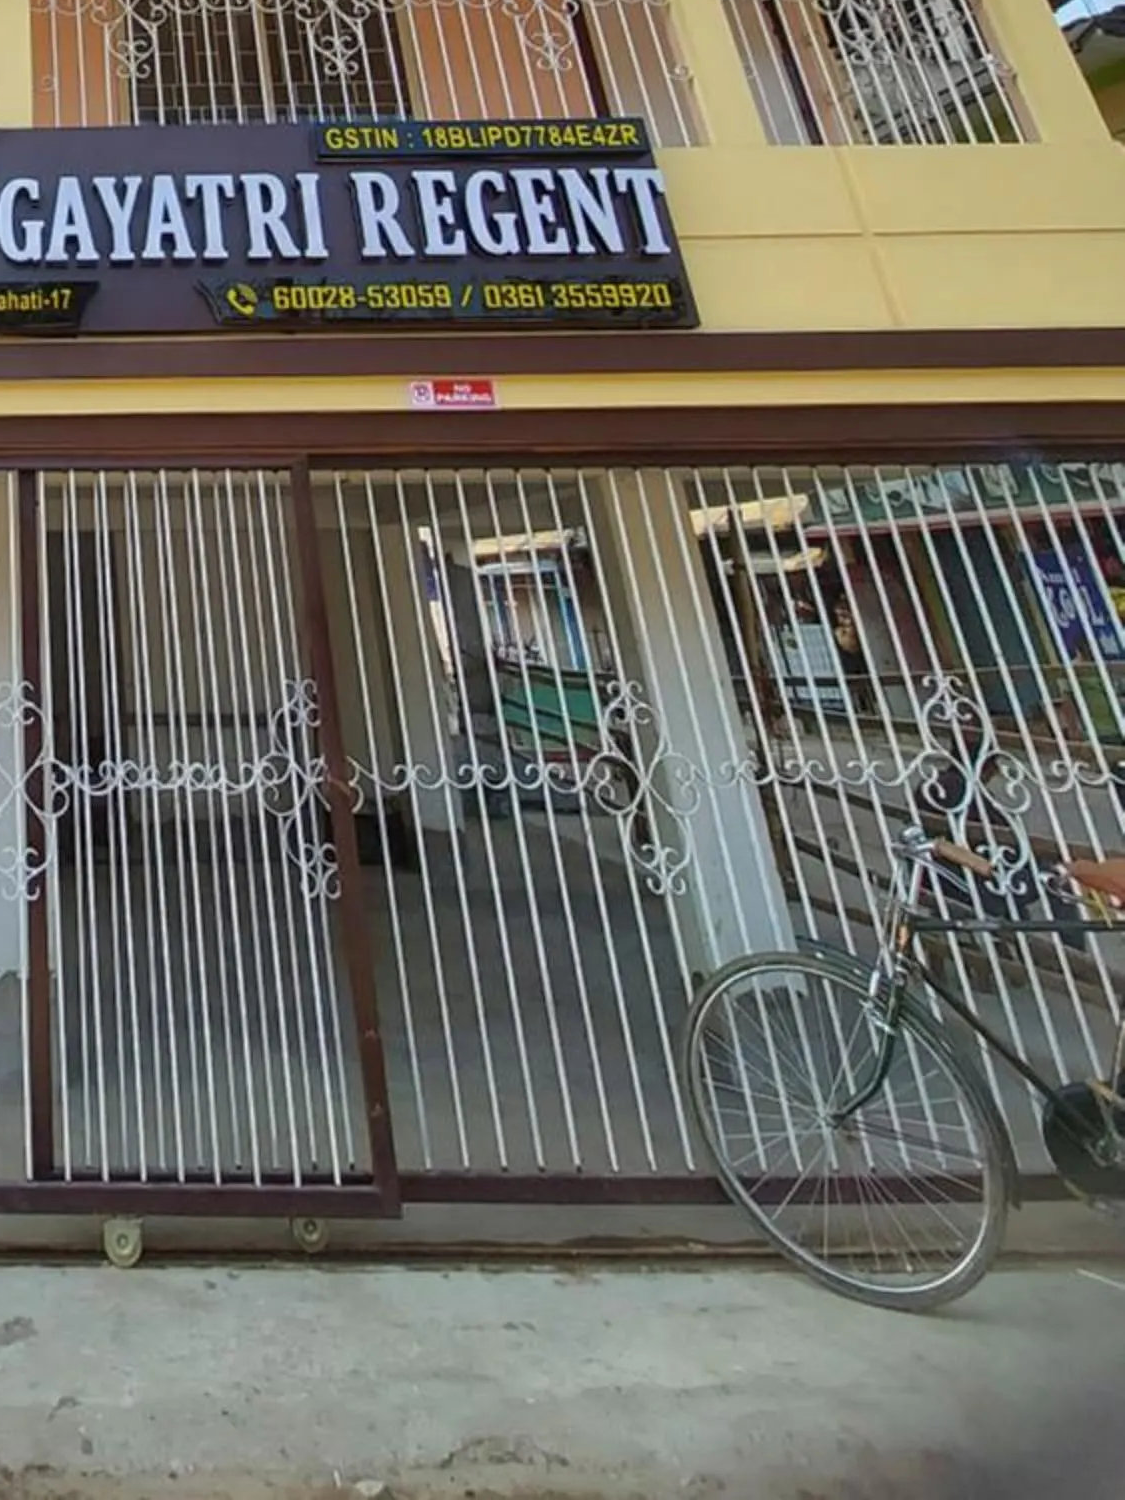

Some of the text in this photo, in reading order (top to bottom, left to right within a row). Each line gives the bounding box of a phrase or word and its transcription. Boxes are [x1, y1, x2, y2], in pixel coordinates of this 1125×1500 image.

[325, 127, 398, 149] GSTIN
[423, 124, 639, 147] 18BLIPD7784E4ZR
[349, 167, 671, 257] REGENT
[275, 283, 671, 309] 60028-53059 / 0361 3559920
